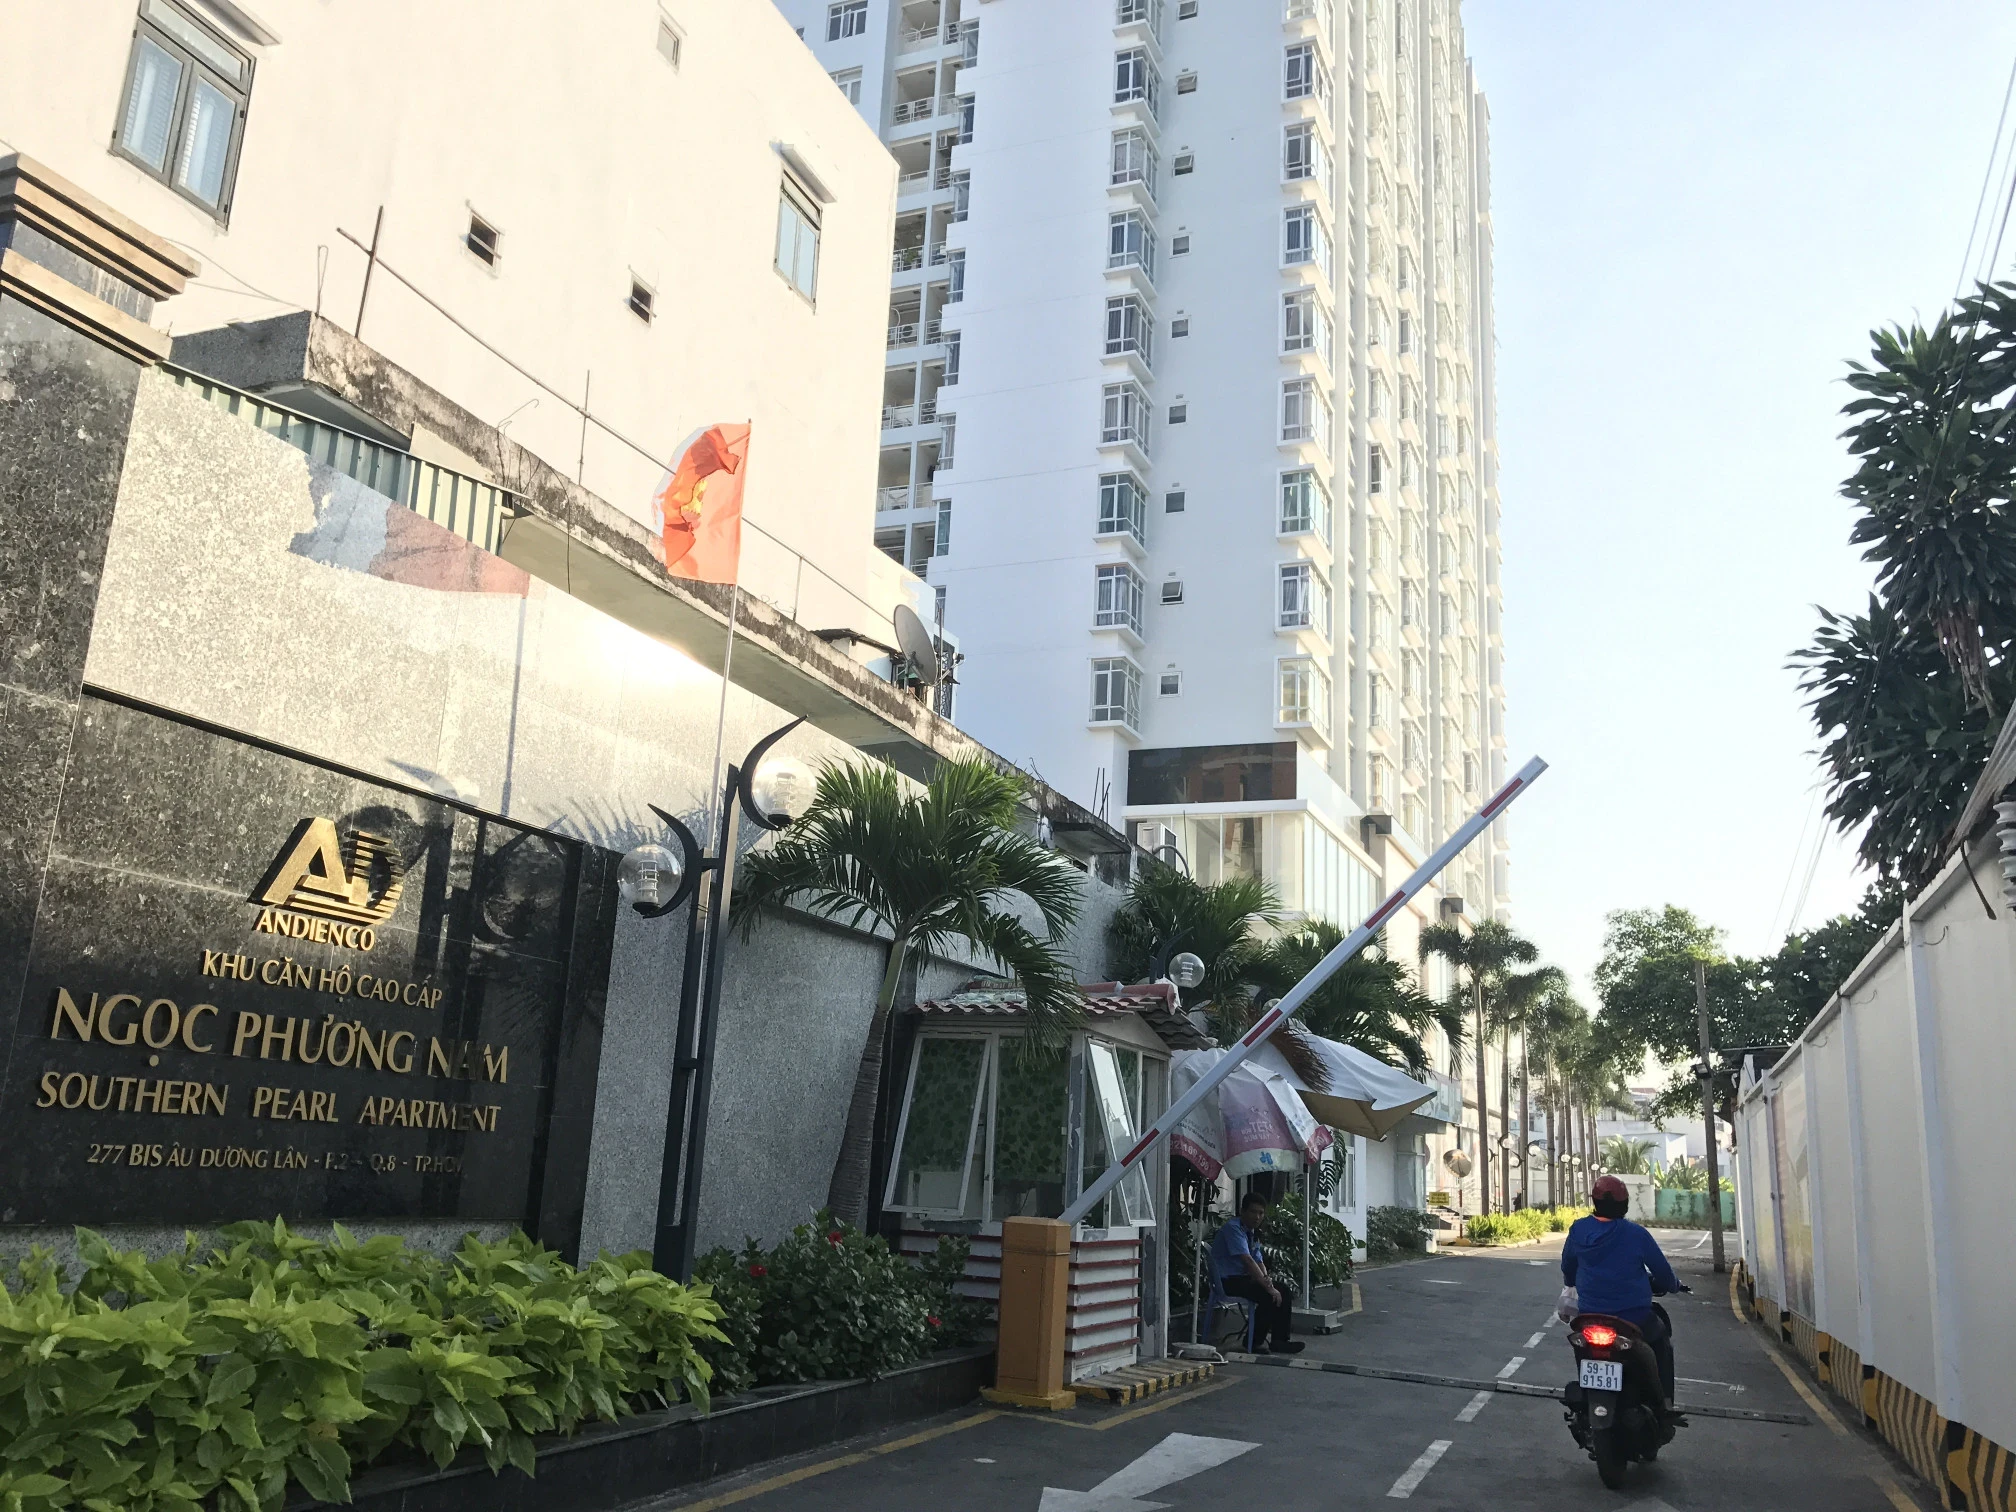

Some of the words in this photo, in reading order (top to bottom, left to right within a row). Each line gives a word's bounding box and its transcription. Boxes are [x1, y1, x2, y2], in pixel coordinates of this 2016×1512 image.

[256, 908, 375, 951] ANDIENCO
[202, 948, 257, 982] KHU
[261, 956, 313, 990] CĂN
[318, 964, 352, 1003] HỘ
[356, 974, 400, 1003] CAO
[403, 974, 443, 1009] CẤP
[51, 986, 219, 1067] NGỌC
[232, 1010, 416, 1074] PHƯƠNG
[427, 1036, 509, 1084] NAM
[36, 1071, 229, 1116] SOUTHERN
[252, 1086, 339, 1123] PEARL
[358, 1095, 502, 1132] APARTMENT
[87, 1143, 126, 1164] 277
[129, 1143, 163, 1167] BIS
[165, 1141, 195, 1167] ÂU
[200, 1145, 268, 1168] DƯƠNG
[273, 1145, 308, 1169] LÂN
[370, 1152, 397, 1175] Q.8
[1582, 1374, 1618, 1389] 915.81
[1586, 1361, 1615, 1377] 59-T1
